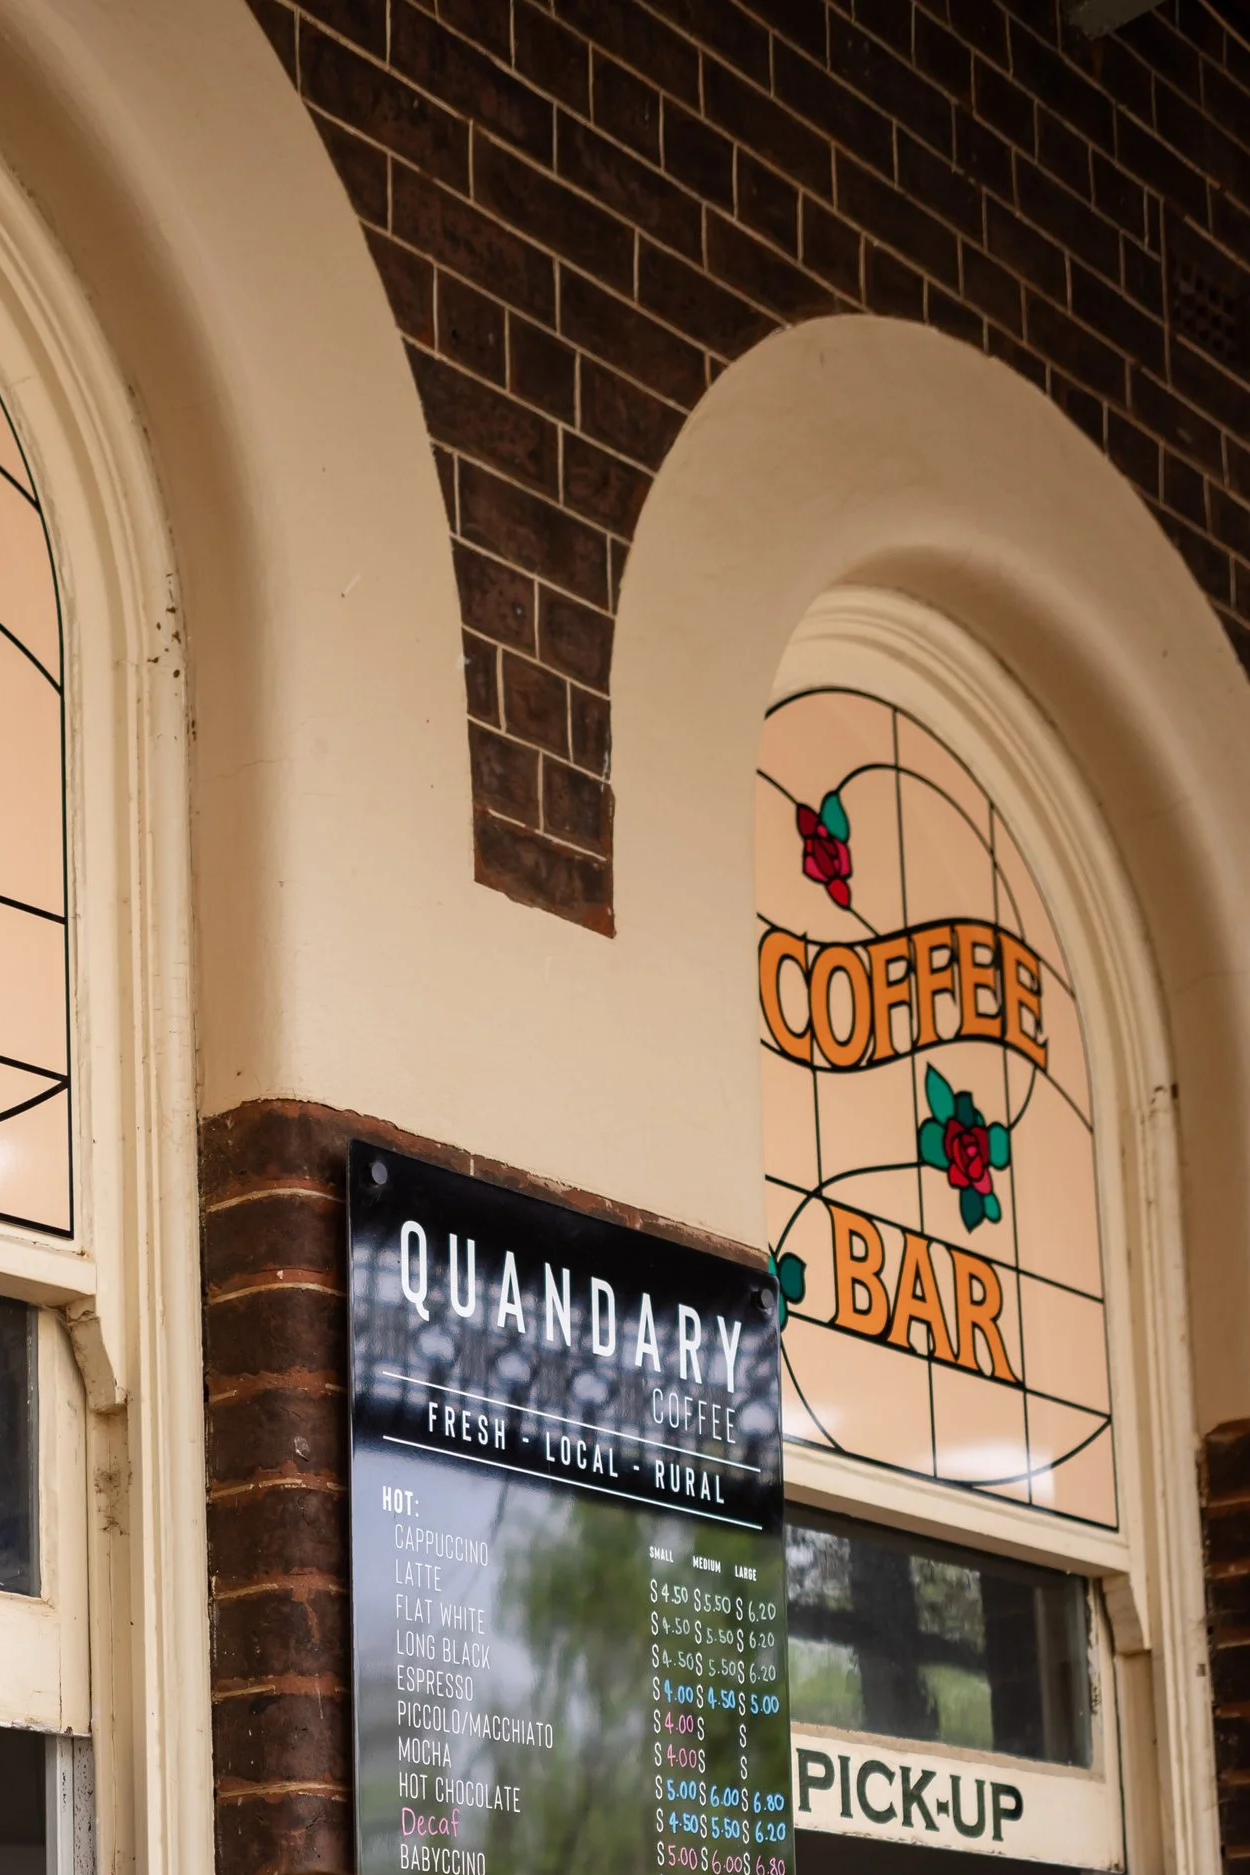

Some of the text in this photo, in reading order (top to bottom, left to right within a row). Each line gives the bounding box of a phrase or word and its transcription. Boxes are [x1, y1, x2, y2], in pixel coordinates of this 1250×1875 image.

[757, 921, 1048, 1070] COFFEE
[399, 1220, 742, 1394] QUANDARY
[827, 1202, 1022, 1384] BAR
[651, 1388, 736, 1444] COFFEE
[428, 1403, 506, 1450] FRESH
[545, 1433, 618, 1477] LOCAL
[655, 1459, 725, 1504] RURAL
[382, 1485, 419, 1517] HOT:
[395, 1524, 488, 1566] CAPPUCCINO
[649, 1546, 757, 1581] SMALL MEDIUM LARGE
[395, 1559, 442, 1591] LATTE
[396, 1594, 485, 1634] FLAT WHITE
[397, 1629, 490, 1669] LONG BLACK
[397, 1665, 473, 1701] ESPRESSO
[398, 1700, 553, 1749] PICCOLO/MACCHIATO
[398, 1736, 451, 1768] MOCHA
[399, 1772, 521, 1813] HOT CHOCOLATE
[796, 1747, 1023, 1842] PICK-UP
[402, 1807, 460, 1837] Decaf
